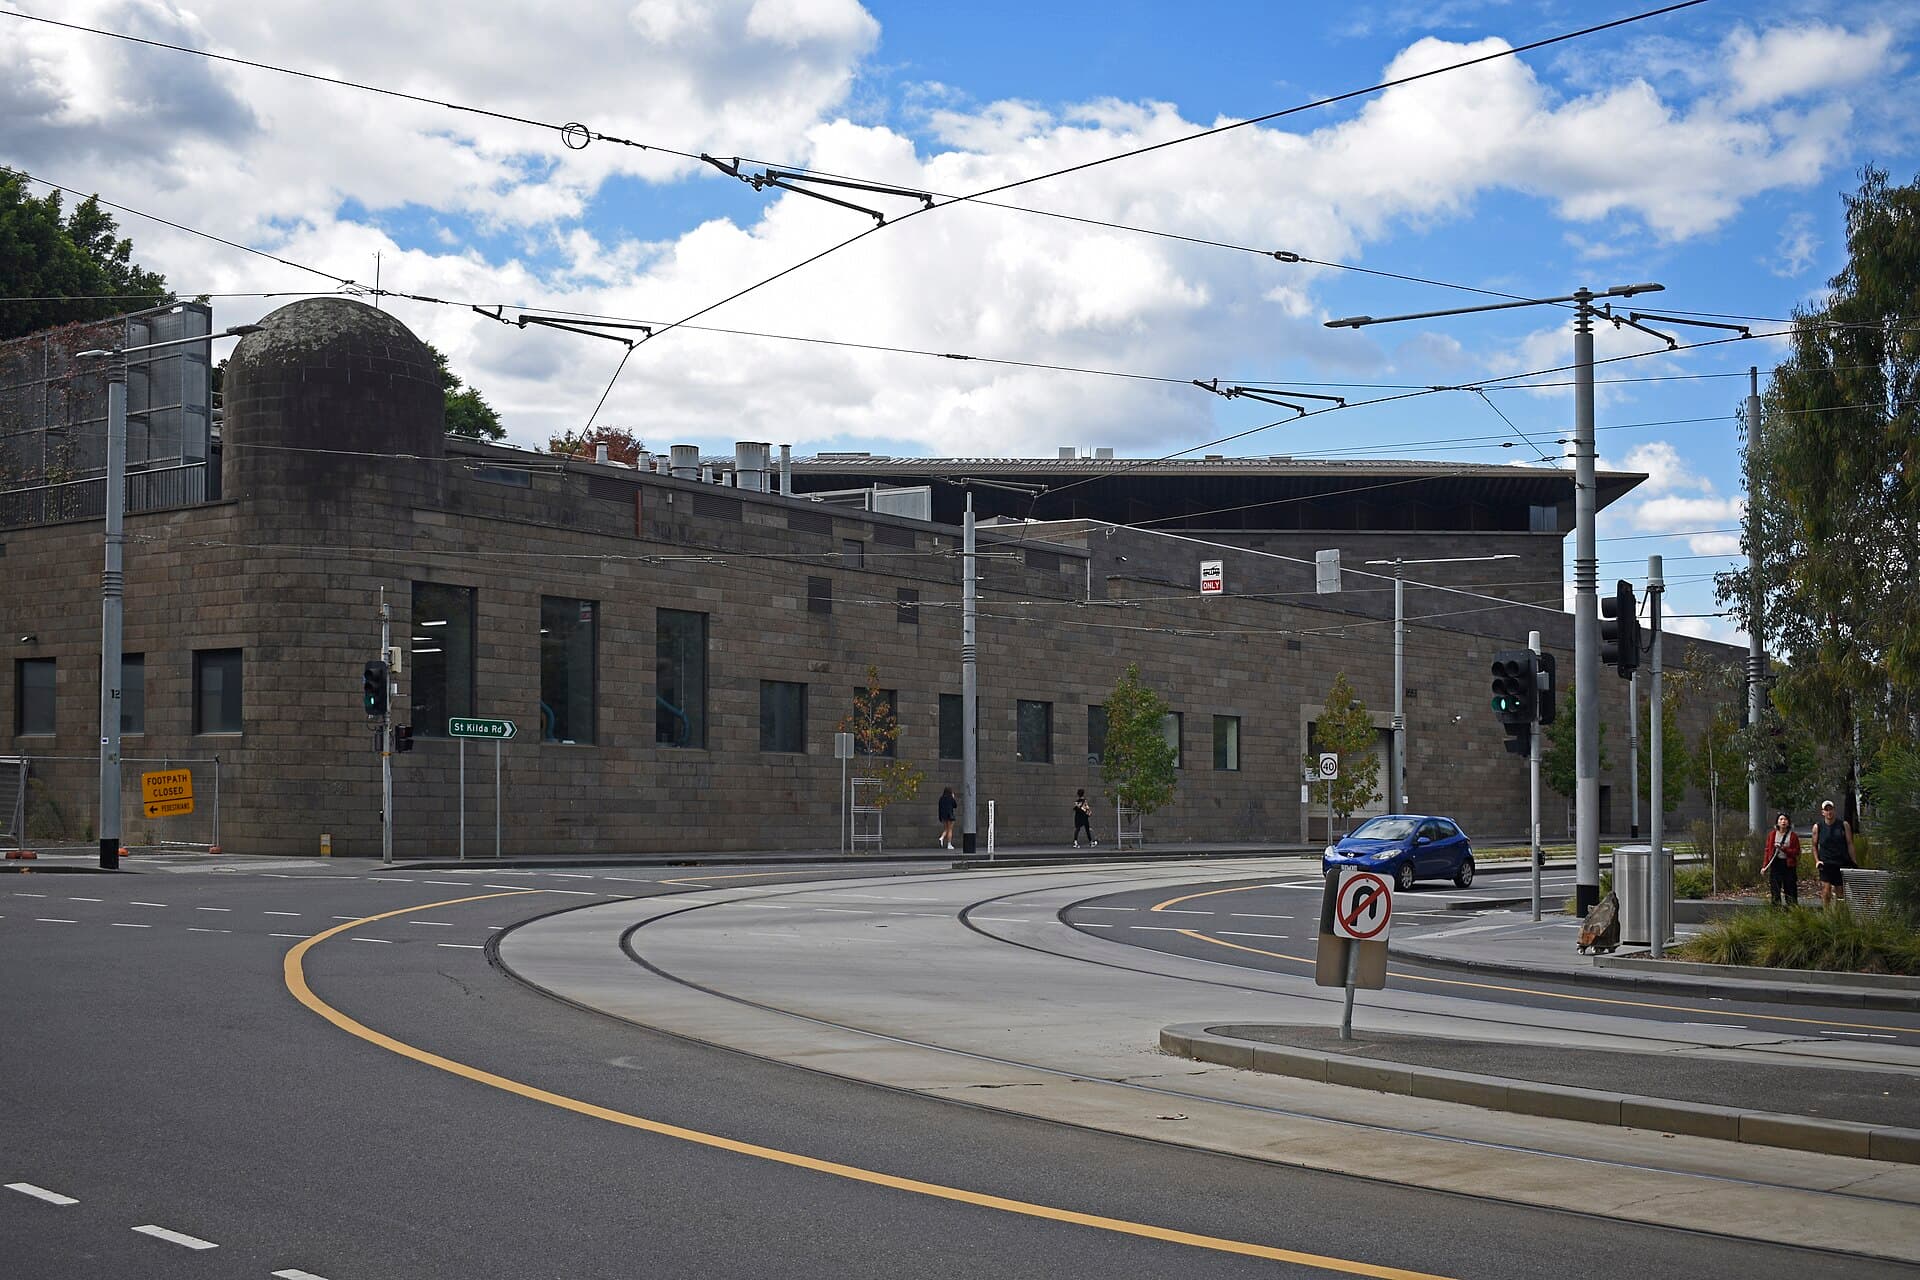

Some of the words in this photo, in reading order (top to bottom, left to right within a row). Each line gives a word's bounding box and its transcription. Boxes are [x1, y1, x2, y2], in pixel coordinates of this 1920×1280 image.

[1203, 581, 1220, 590] ONLY
[454, 723, 464, 731] St
[466, 724, 489, 733] Kilda
[491, 725, 502, 733] Rd
[1323, 762, 1334, 771] 40
[147, 774, 188, 786] FOOTPATH
[153, 786, 184, 798] CLOSED
